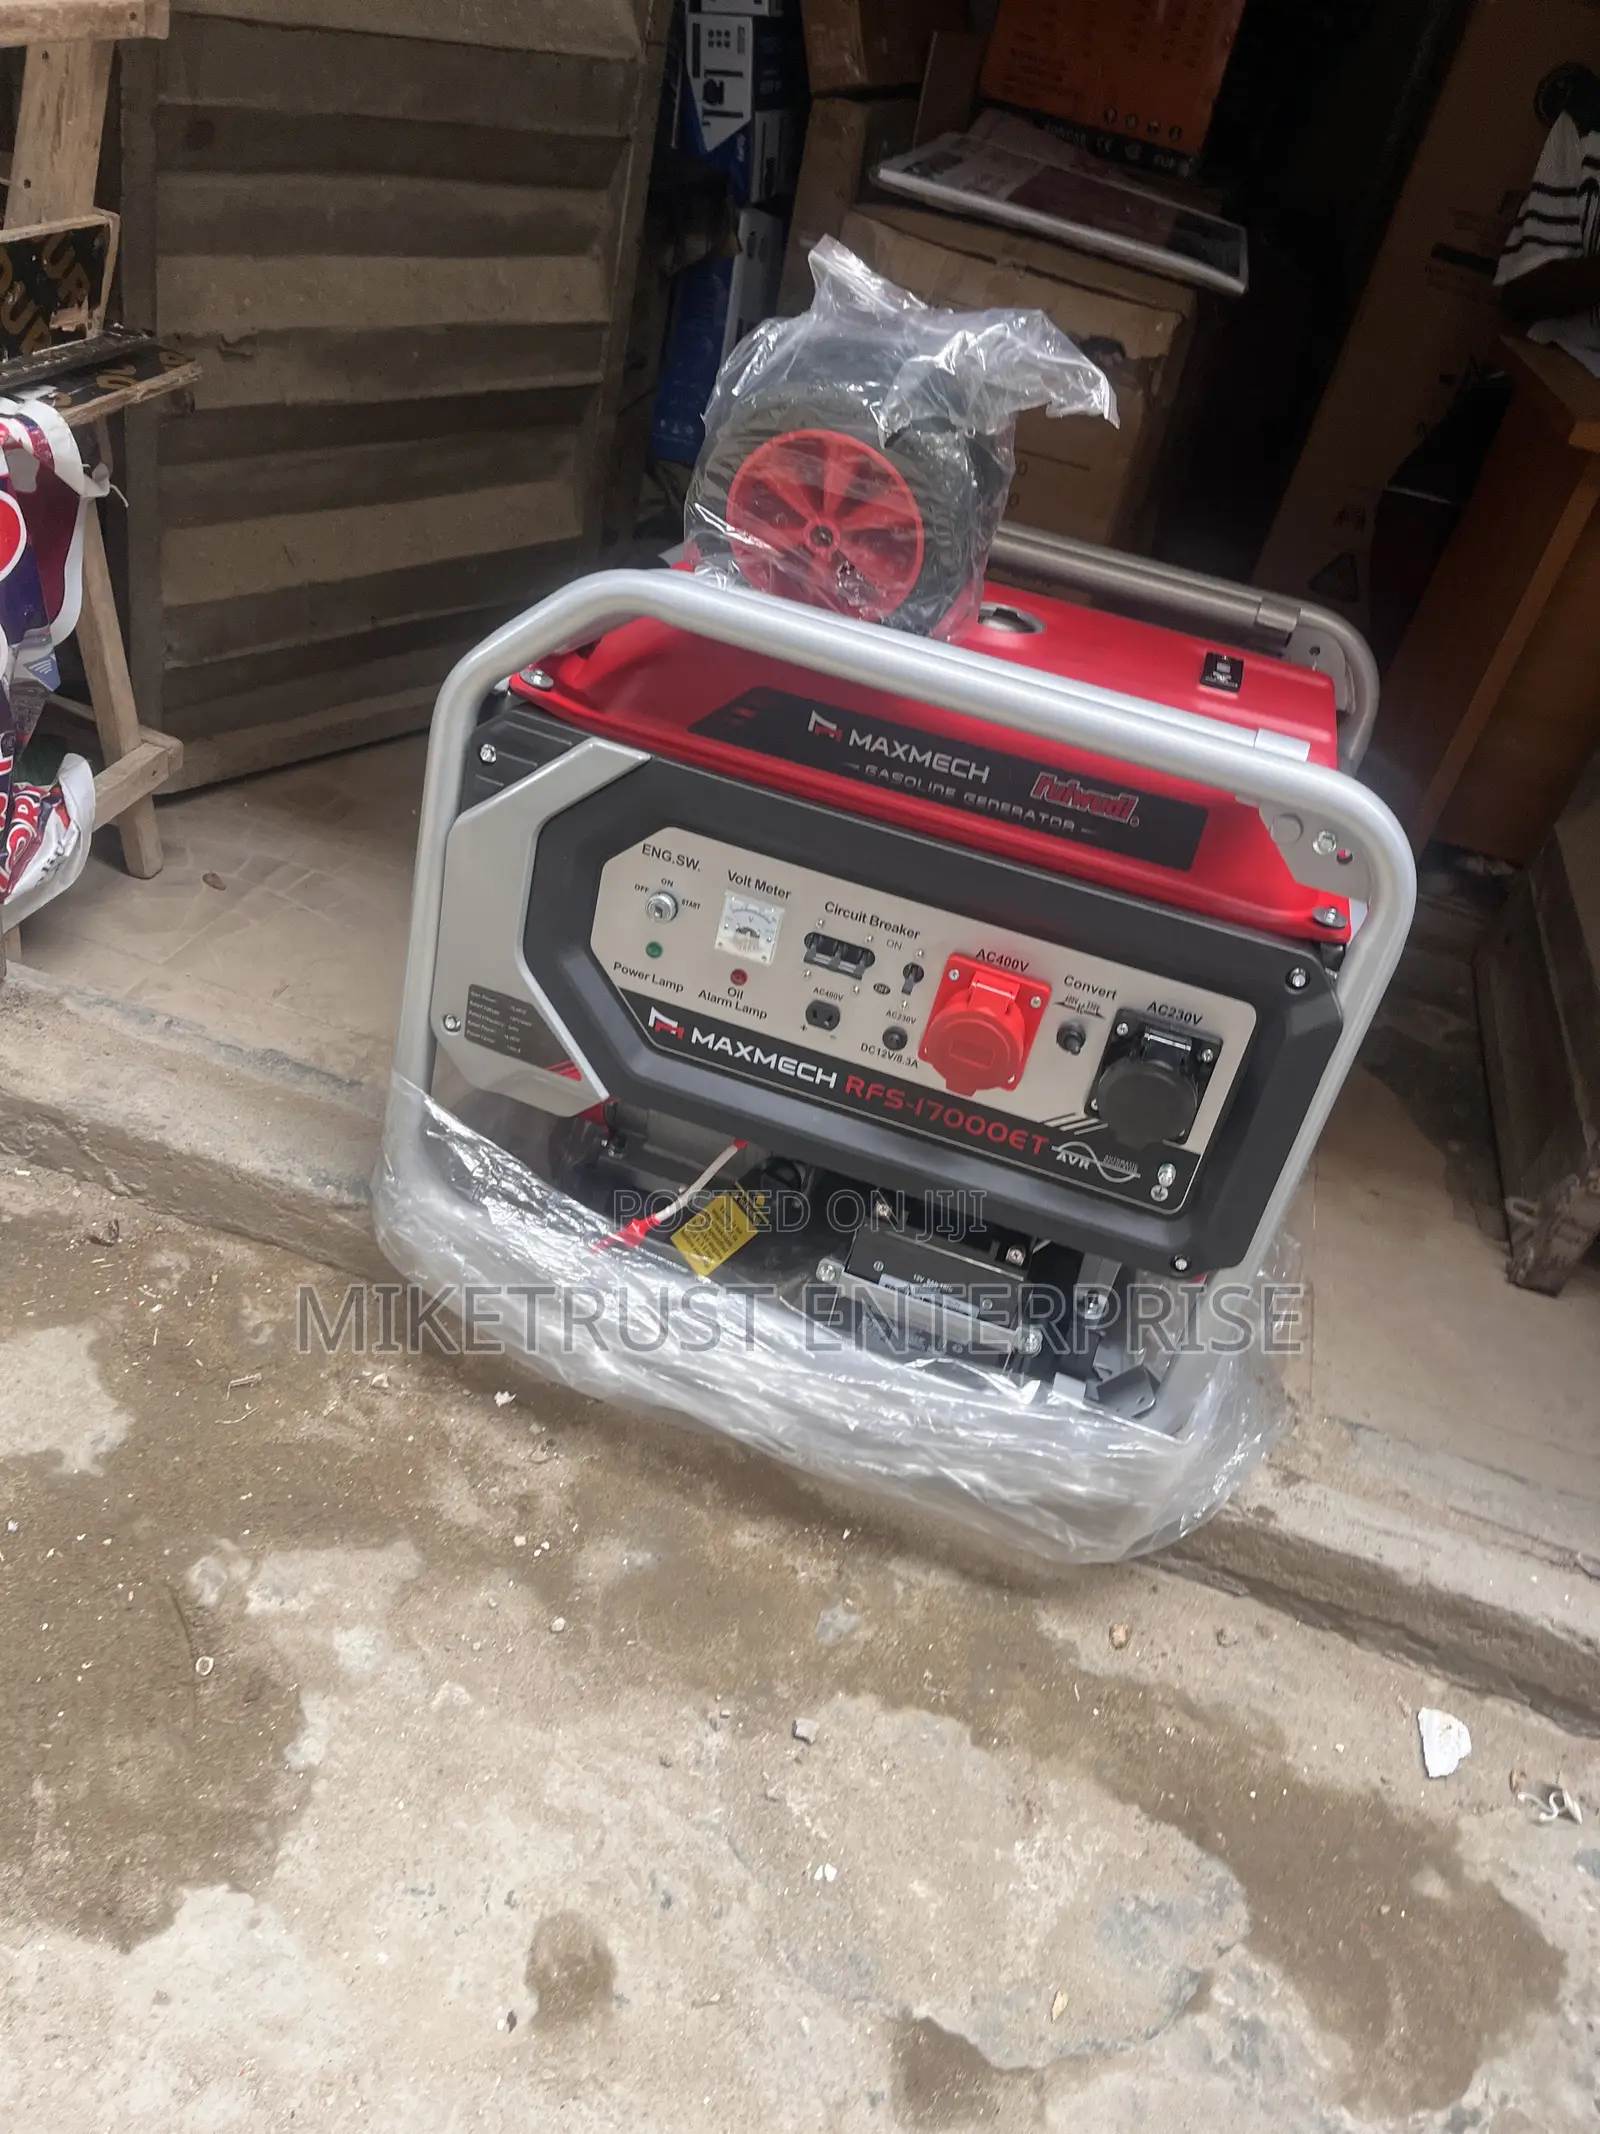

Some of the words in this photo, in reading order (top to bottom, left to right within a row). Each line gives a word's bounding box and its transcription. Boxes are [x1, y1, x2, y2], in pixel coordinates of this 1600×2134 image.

[849, 728, 991, 783] MAXMECH
[865, 764, 957, 797] GASOLINE
[964, 791, 1076, 833] GENERATOR
[642, 843, 701, 872] ENG.SW.
[634, 883, 649, 893] OFF
[661, 877, 674, 887] ON
[727, 869, 752, 889] Volt
[754, 879, 792, 900] Meter
[681, 898, 701, 910] START
[824, 900, 867, 925] Circuit
[870, 915, 920, 940] Breaker
[886, 938, 903, 950] ON
[975, 948, 1029, 973] AC400V
[612, 960, 650, 982] Power
[651, 973, 684, 993] Lamp
[1063, 974, 1117, 1001] Convert
[698, 989, 733, 1009] Alarm
[735, 1000, 768, 1020] Lamp
[727, 986, 744, 1000] Oil
[1147, 1001, 1203, 1026] AC230V
[691, 1026, 837, 1089] MAXMECH
[844, 1074, 1050, 1156] RFS-17000ET
[1056, 1152, 1091, 1170] AVR
